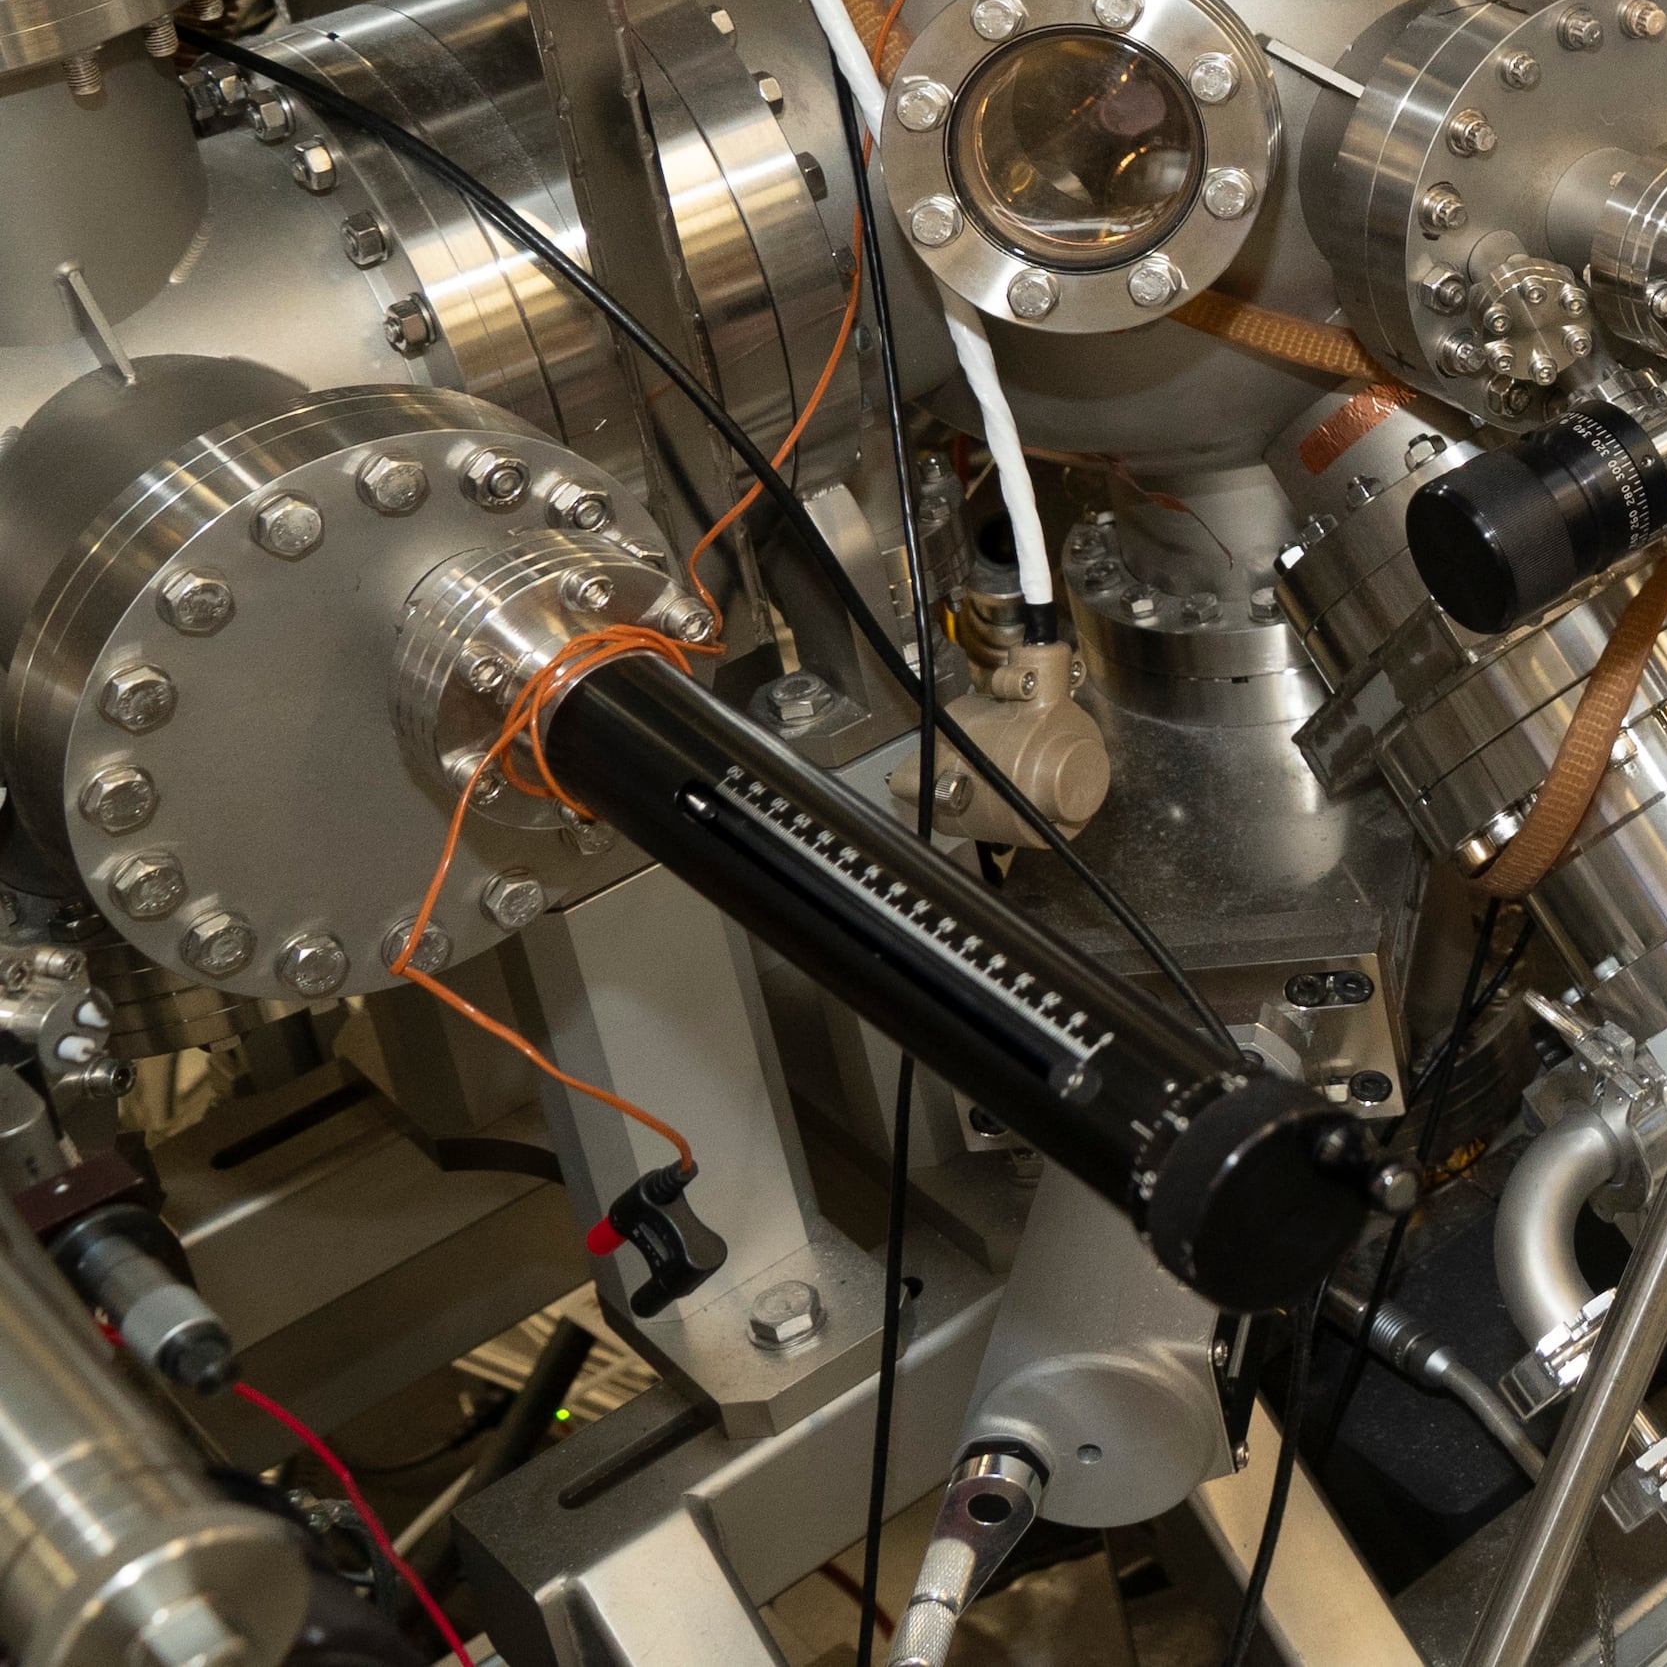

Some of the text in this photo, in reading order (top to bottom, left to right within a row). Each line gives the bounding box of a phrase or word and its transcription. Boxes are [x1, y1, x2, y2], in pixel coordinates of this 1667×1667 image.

[1573, 425, 1592, 438] 340
[1591, 440, 1610, 457] 320
[1608, 460, 1625, 481] 300
[1621, 485, 1635, 507] 280
